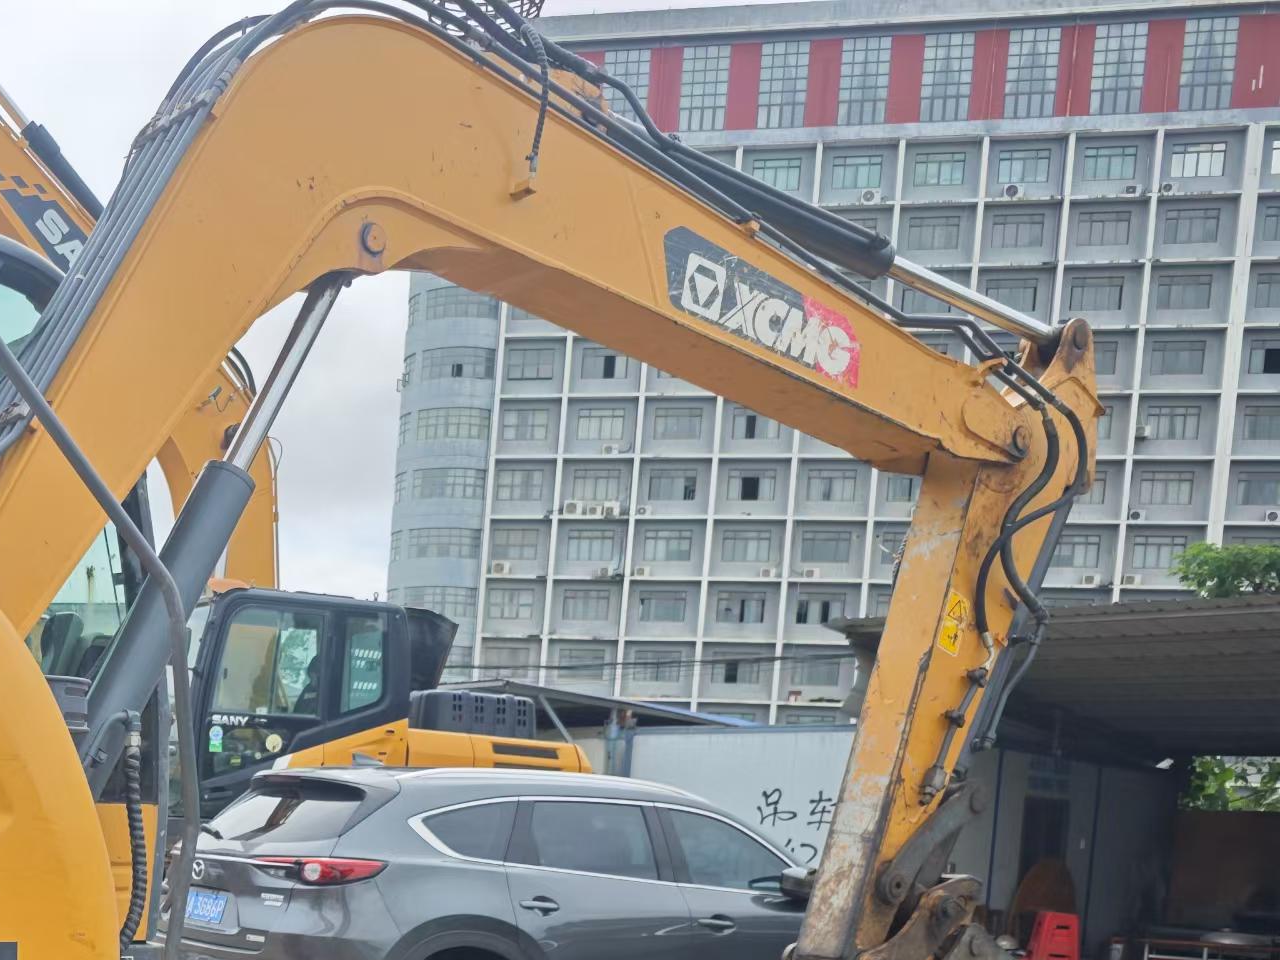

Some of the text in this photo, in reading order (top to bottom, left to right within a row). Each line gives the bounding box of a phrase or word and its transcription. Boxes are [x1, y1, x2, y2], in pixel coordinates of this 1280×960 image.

[35, 208, 84, 268] SA
[719, 279, 852, 377] XCMG
[211, 714, 249, 727] SANY
